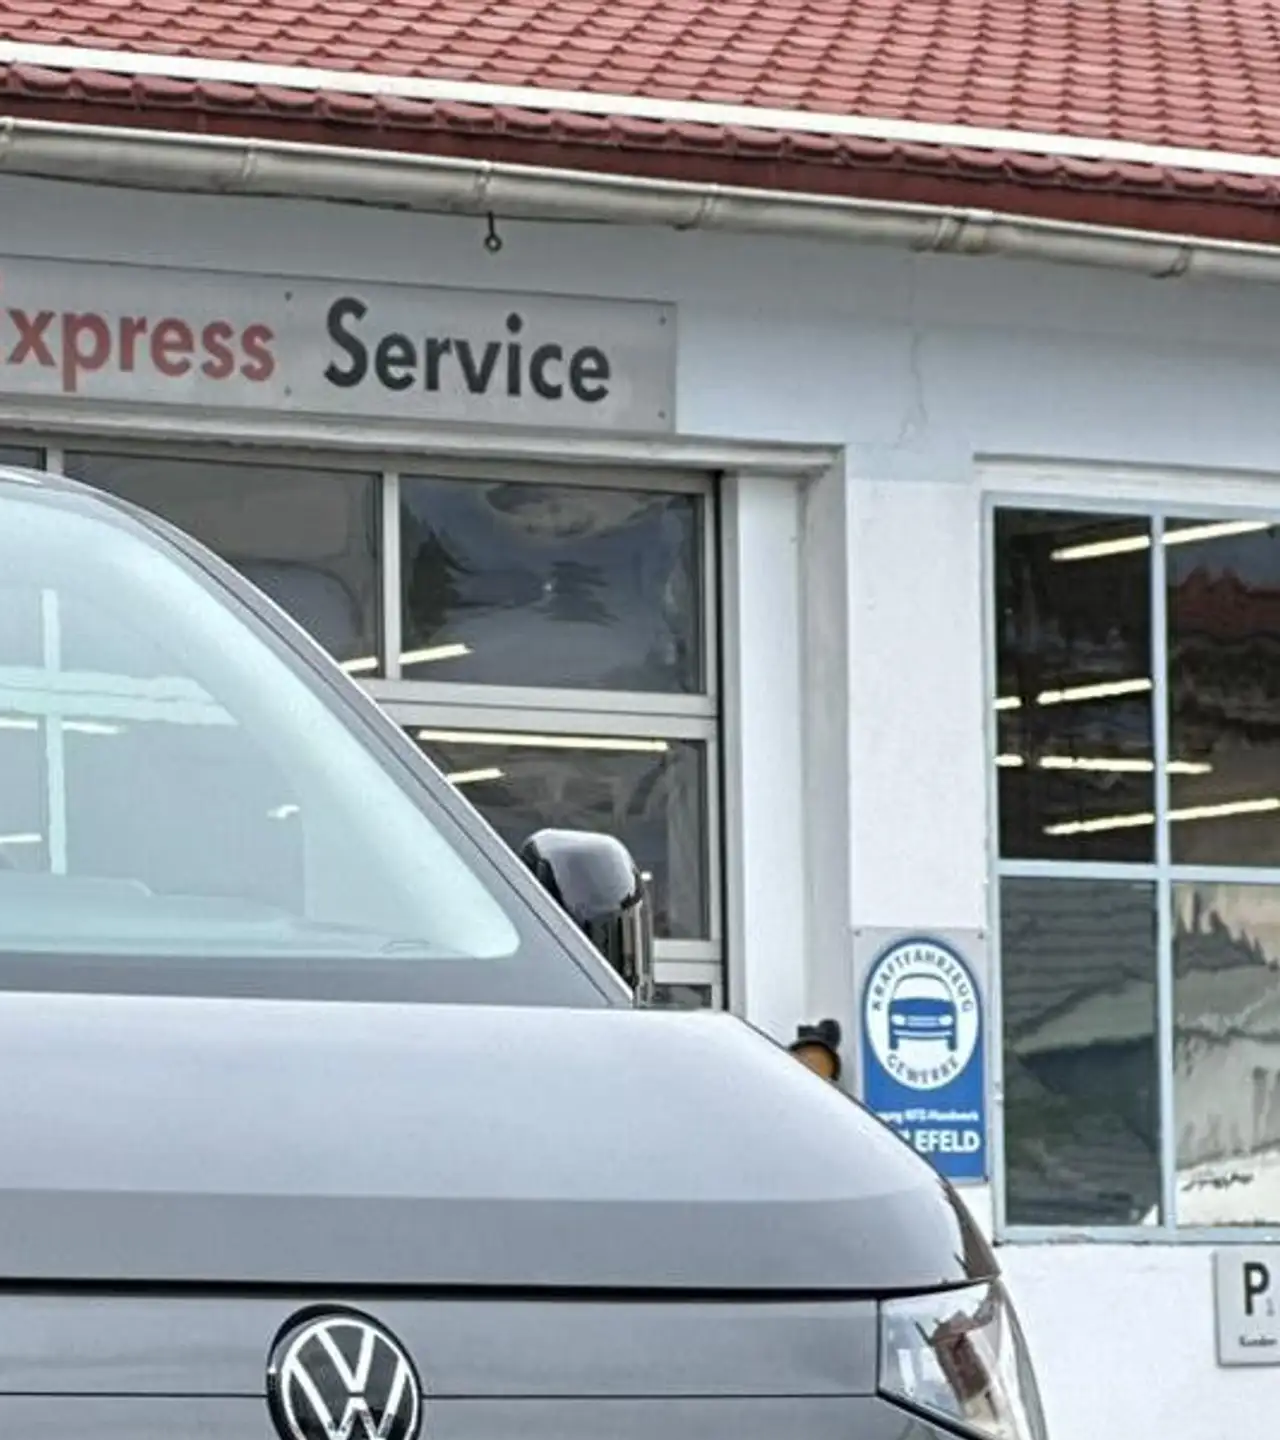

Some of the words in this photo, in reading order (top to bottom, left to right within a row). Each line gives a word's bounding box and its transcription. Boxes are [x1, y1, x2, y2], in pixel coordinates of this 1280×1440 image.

[325, 296, 612, 402] Service
[897, 1129, 981, 1152] EFELD
[1243, 1261, 1270, 1317] P
